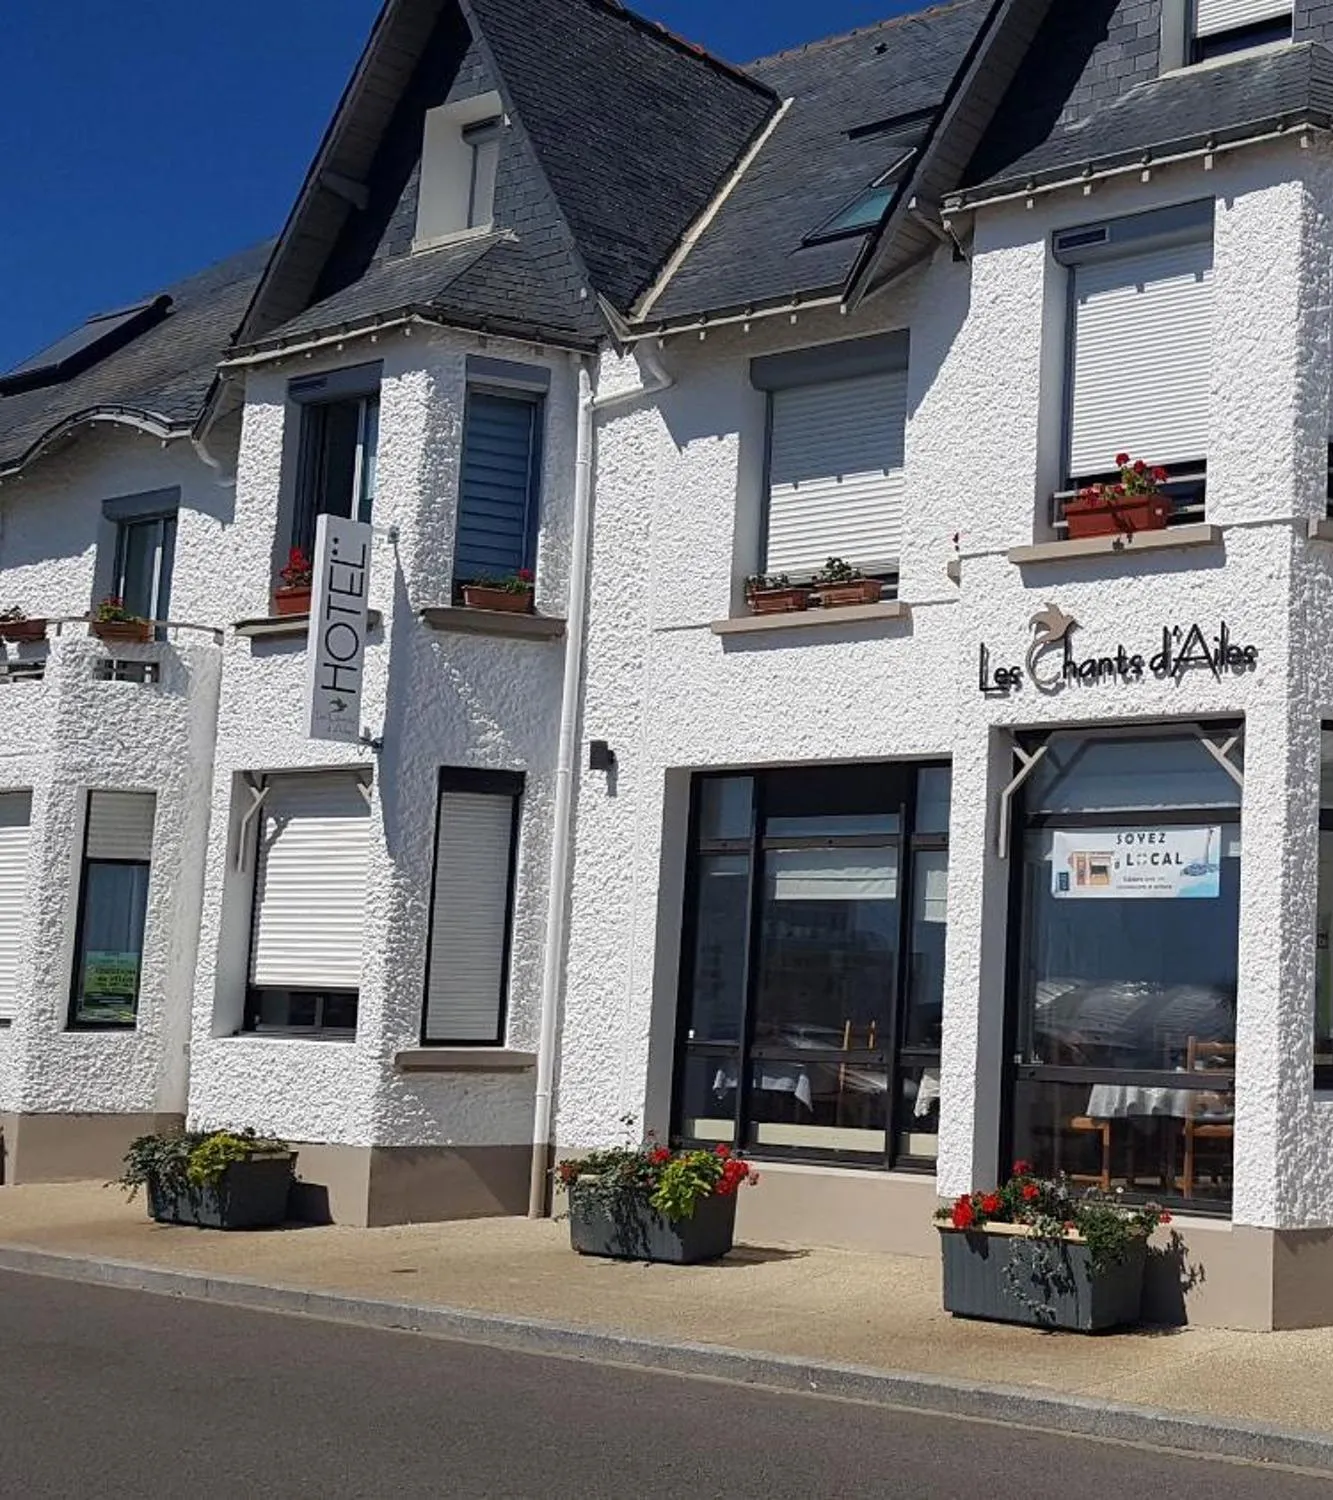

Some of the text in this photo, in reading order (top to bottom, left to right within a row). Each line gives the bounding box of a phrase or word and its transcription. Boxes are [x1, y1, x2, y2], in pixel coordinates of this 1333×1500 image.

[979, 620, 1258, 692] Les Chants d'Ailes
